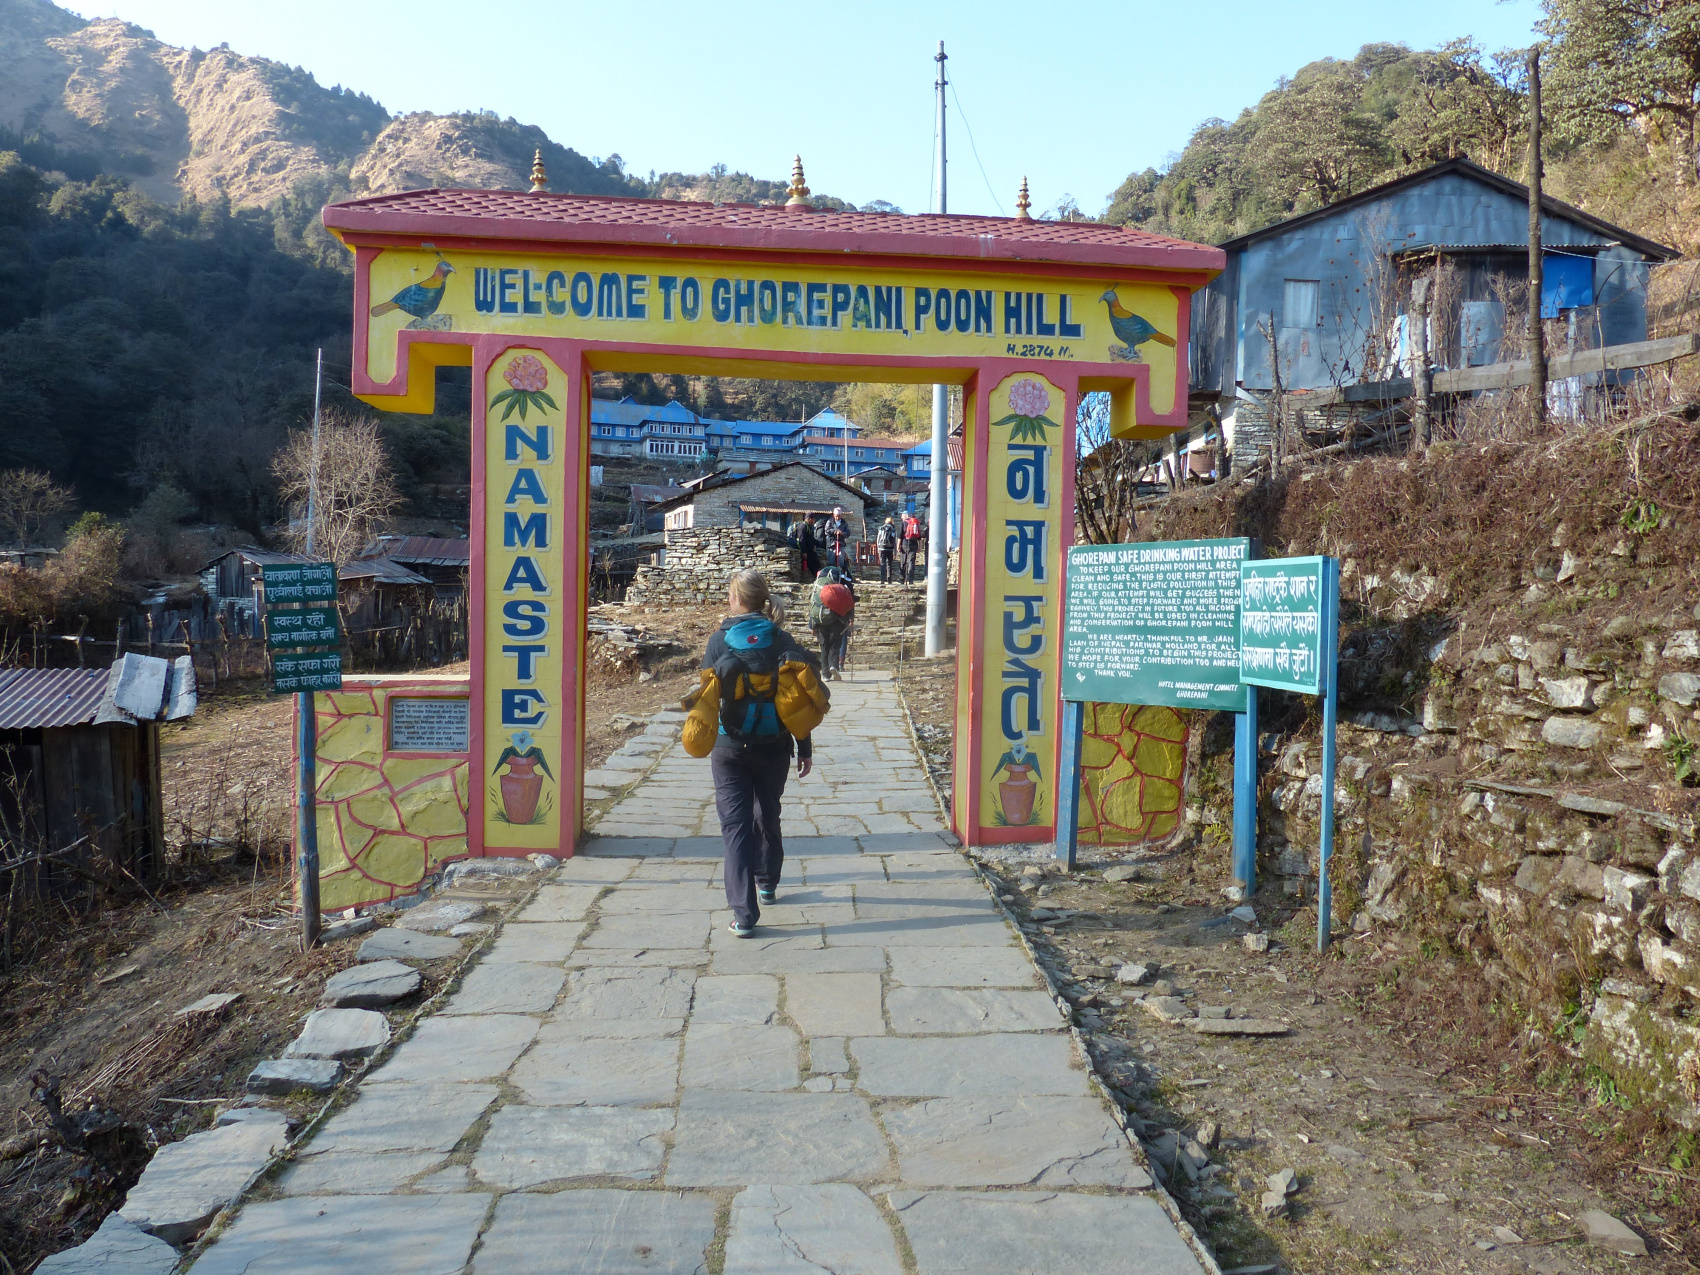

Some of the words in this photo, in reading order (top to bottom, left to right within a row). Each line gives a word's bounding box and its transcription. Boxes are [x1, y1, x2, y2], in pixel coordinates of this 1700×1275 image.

[658, 275, 703, 323] TO
[914, 287, 996, 338] POON
[1004, 291, 1085, 341] HILL
[1072, 551, 1116, 566] GHOREPANI
[1118, 550, 1140, 564] SAFE
[1140, 548, 1180, 563] DRINKING
[1181, 546, 1212, 561] WATER
[1213, 545, 1246, 560] PROJECT
[1079, 566, 1088, 574] TO
[1089, 565, 1109, 574] KEEP
[1111, 565, 1126, 573] OUR
[1128, 563, 1172, 573] GHOREPANI
[1173, 562, 1195, 571] POON
[1196, 562, 1213, 570] HILL
[1216, 561, 1238, 570] AREA
[264, 569, 301, 583] वातावरण
[501, 424, 555, 729] NAMASTE
[1136, 573, 1154, 581] THIS
[1156, 572, 1164, 580] IS
[1166, 572, 1183, 580] OUR
[1184, 571, 1206, 580] FIRST
[1208, 571, 1241, 580] ATTEMPT
[1088, 582, 1124, 590] REDUCING
[1126, 582, 1139, 590] THE
[1170, 580, 1206, 589] POLLUTION
[1207, 580, 1215, 588] IN
[1217, 579, 1237, 588] THIS
[1289, 576, 1309, 602] शान
[1308, 576, 1318, 600] र
[1000, 443, 1053, 743] नमस्ते
[1118, 590, 1148, 598] ATTEMPT
[1167, 589, 1183, 597] GET
[1185, 589, 1217, 597] SUCCESS
[1219, 588, 1241, 597] THEN
[1199, 597, 1218, 605] MORE
[1167, 612, 1187, 620] USED
[1189, 612, 1197, 620] IN
[1199, 612, 1235, 620] CLEANING
[273, 616, 303, 628] स्वस्थ
[1191, 620, 1212, 628] POON
[1215, 620, 1234, 628] HILL
[1292, 606, 1318, 638] यसको
[1213, 635, 1234, 643] JAAN
[1129, 641, 1163, 649] PARIWAR
[1165, 642, 1199, 650] HOLLAND
[1201, 643, 1217, 651] FOR
[1220, 643, 1236, 651] ALL
[1084, 647, 1145, 655] CONTRIBUTIONS
[1162, 649, 1188, 657] BEGIN
[1189, 650, 1206, 658] THIS
[275, 658, 298, 674] सके
[1081, 654, 1102, 662] HOPE
[1121, 655, 1141, 663] YOUR
[1142, 656, 1194, 665] CONTRIBUTION
[1194, 658, 1210, 667] TOO
[1212, 659, 1226, 667] AND
[1227, 659, 1241, 668] HEL
[1094, 669, 1116, 677] THANK
[1175, 682, 1214, 691] MANAGEMENT
[1176, 690, 1209, 699] GHOREPANI
